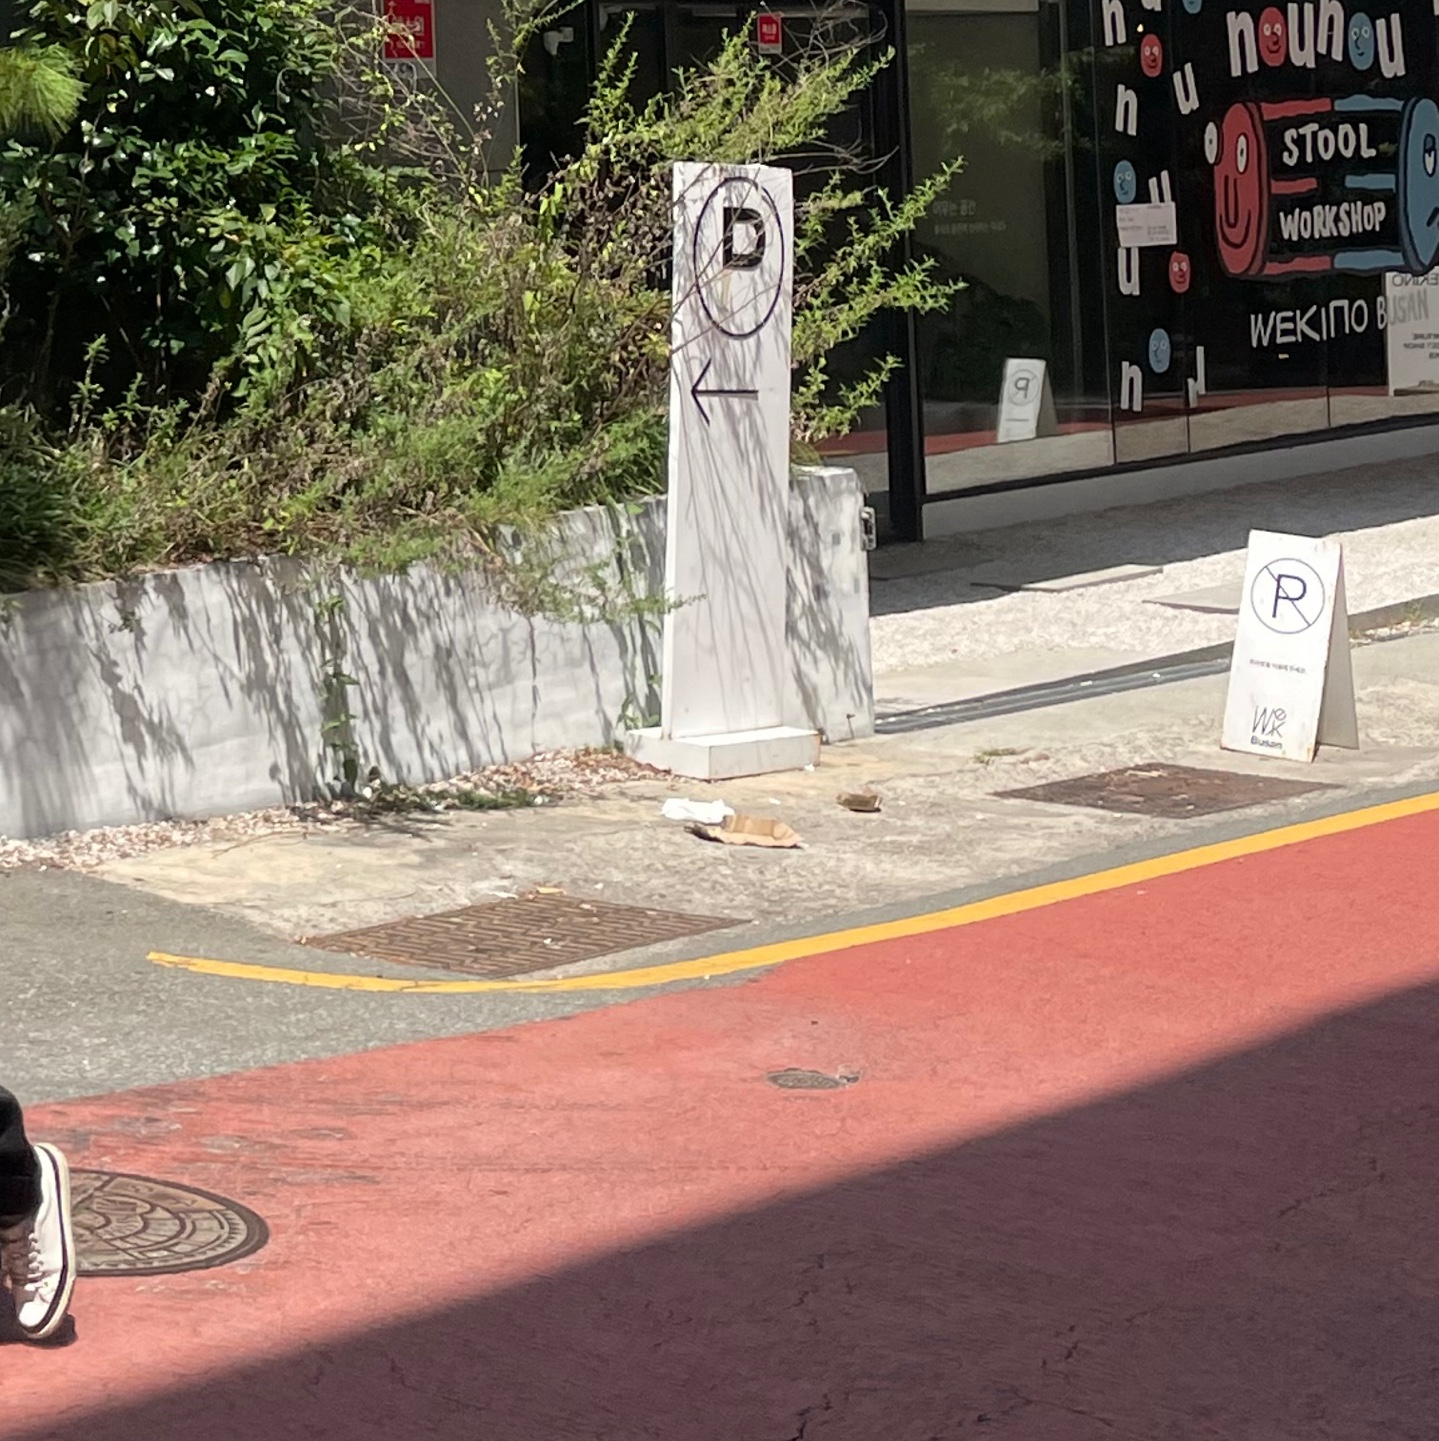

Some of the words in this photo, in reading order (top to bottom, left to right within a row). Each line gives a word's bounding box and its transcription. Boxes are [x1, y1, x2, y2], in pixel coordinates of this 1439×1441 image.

[1282, 122, 1377, 167] STOOL
[1279, 200, 1386, 242] WORKSHOP
[1376, 288, 1430, 330] BUSAN
[1271, 573, 1307, 619] P
[1250, 735, 1283, 750] Busan
